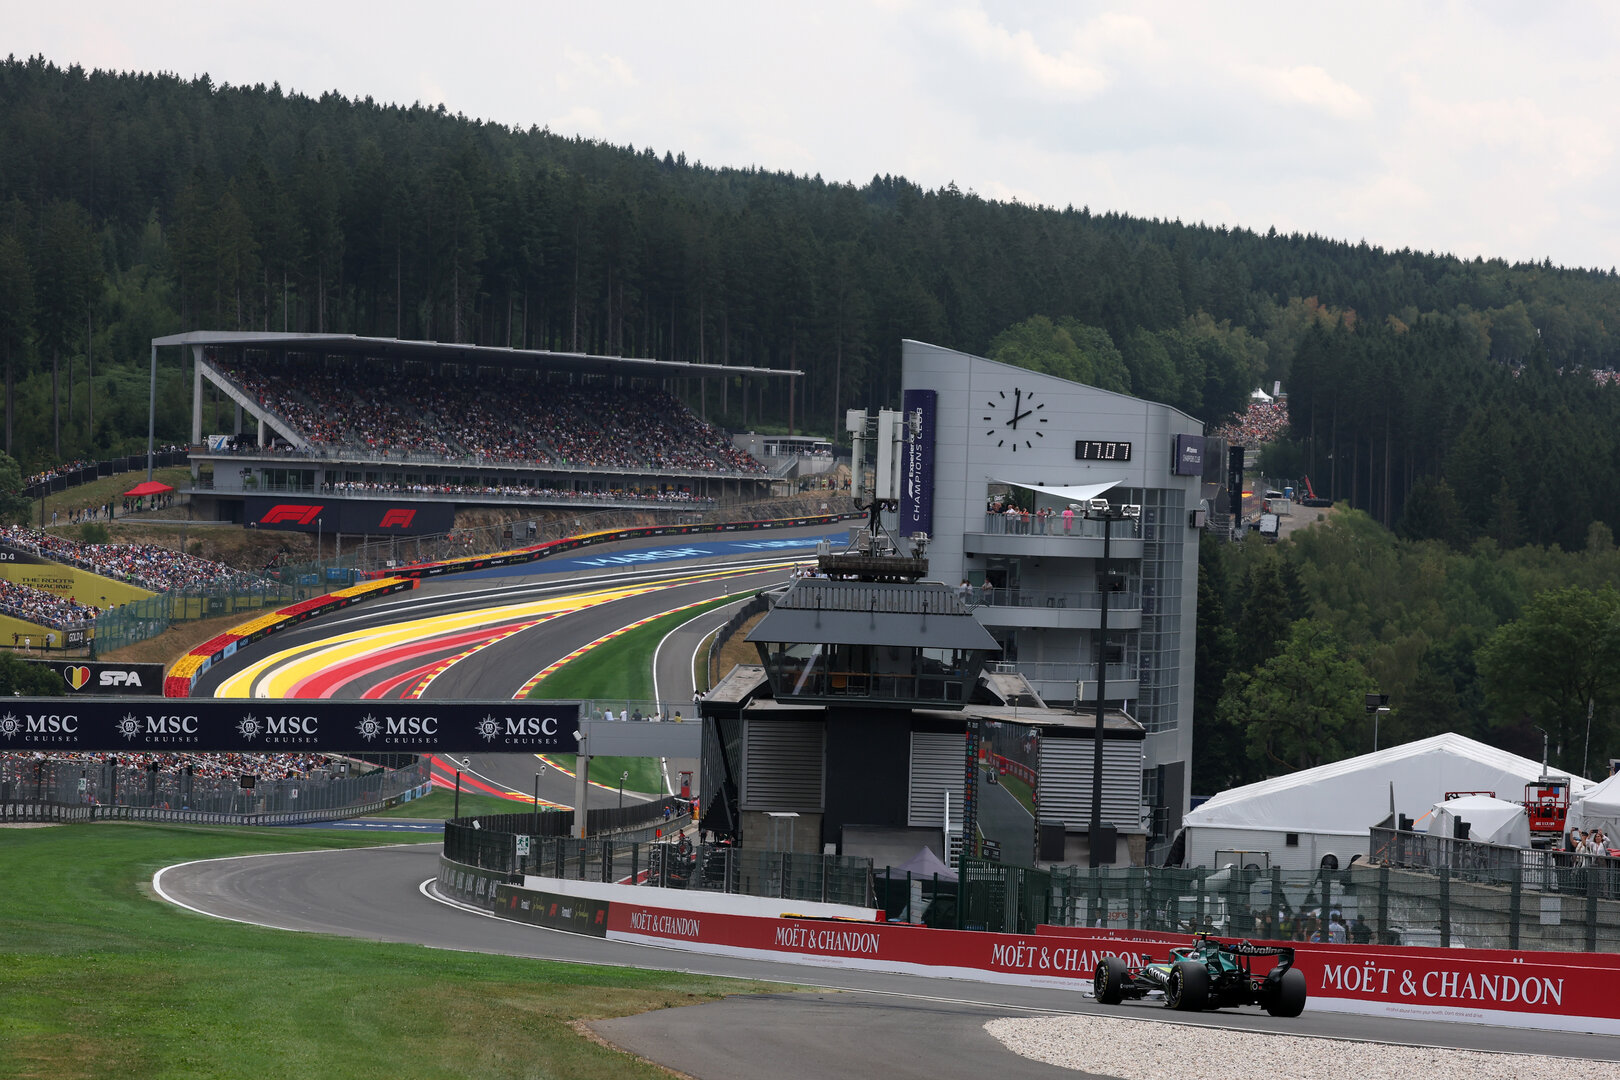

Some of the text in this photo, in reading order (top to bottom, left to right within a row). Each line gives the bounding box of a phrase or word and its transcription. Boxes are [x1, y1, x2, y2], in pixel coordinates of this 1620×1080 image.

[913, 444, 923, 521] CHAMPIONS
[69, 632, 80, 642] GOLD
[99, 671, 142, 687] SPA
[26, 715, 78, 732] MSC
[146, 716, 198, 734] MSC
[266, 716, 318, 734] MSC
[386, 717, 438, 734] MSC
[506, 717, 558, 735] MSC
[630, 910, 700, 937] MOËT & CHANDON
[775, 924, 880, 954] MOËT & CHANDON
[991, 941, 1038, 968] MOËT
[1039, 946, 1051, 969] &
[1238, 943, 1284, 955] Valvoline
[1321, 960, 1564, 1006] MOËT & CHANDON
